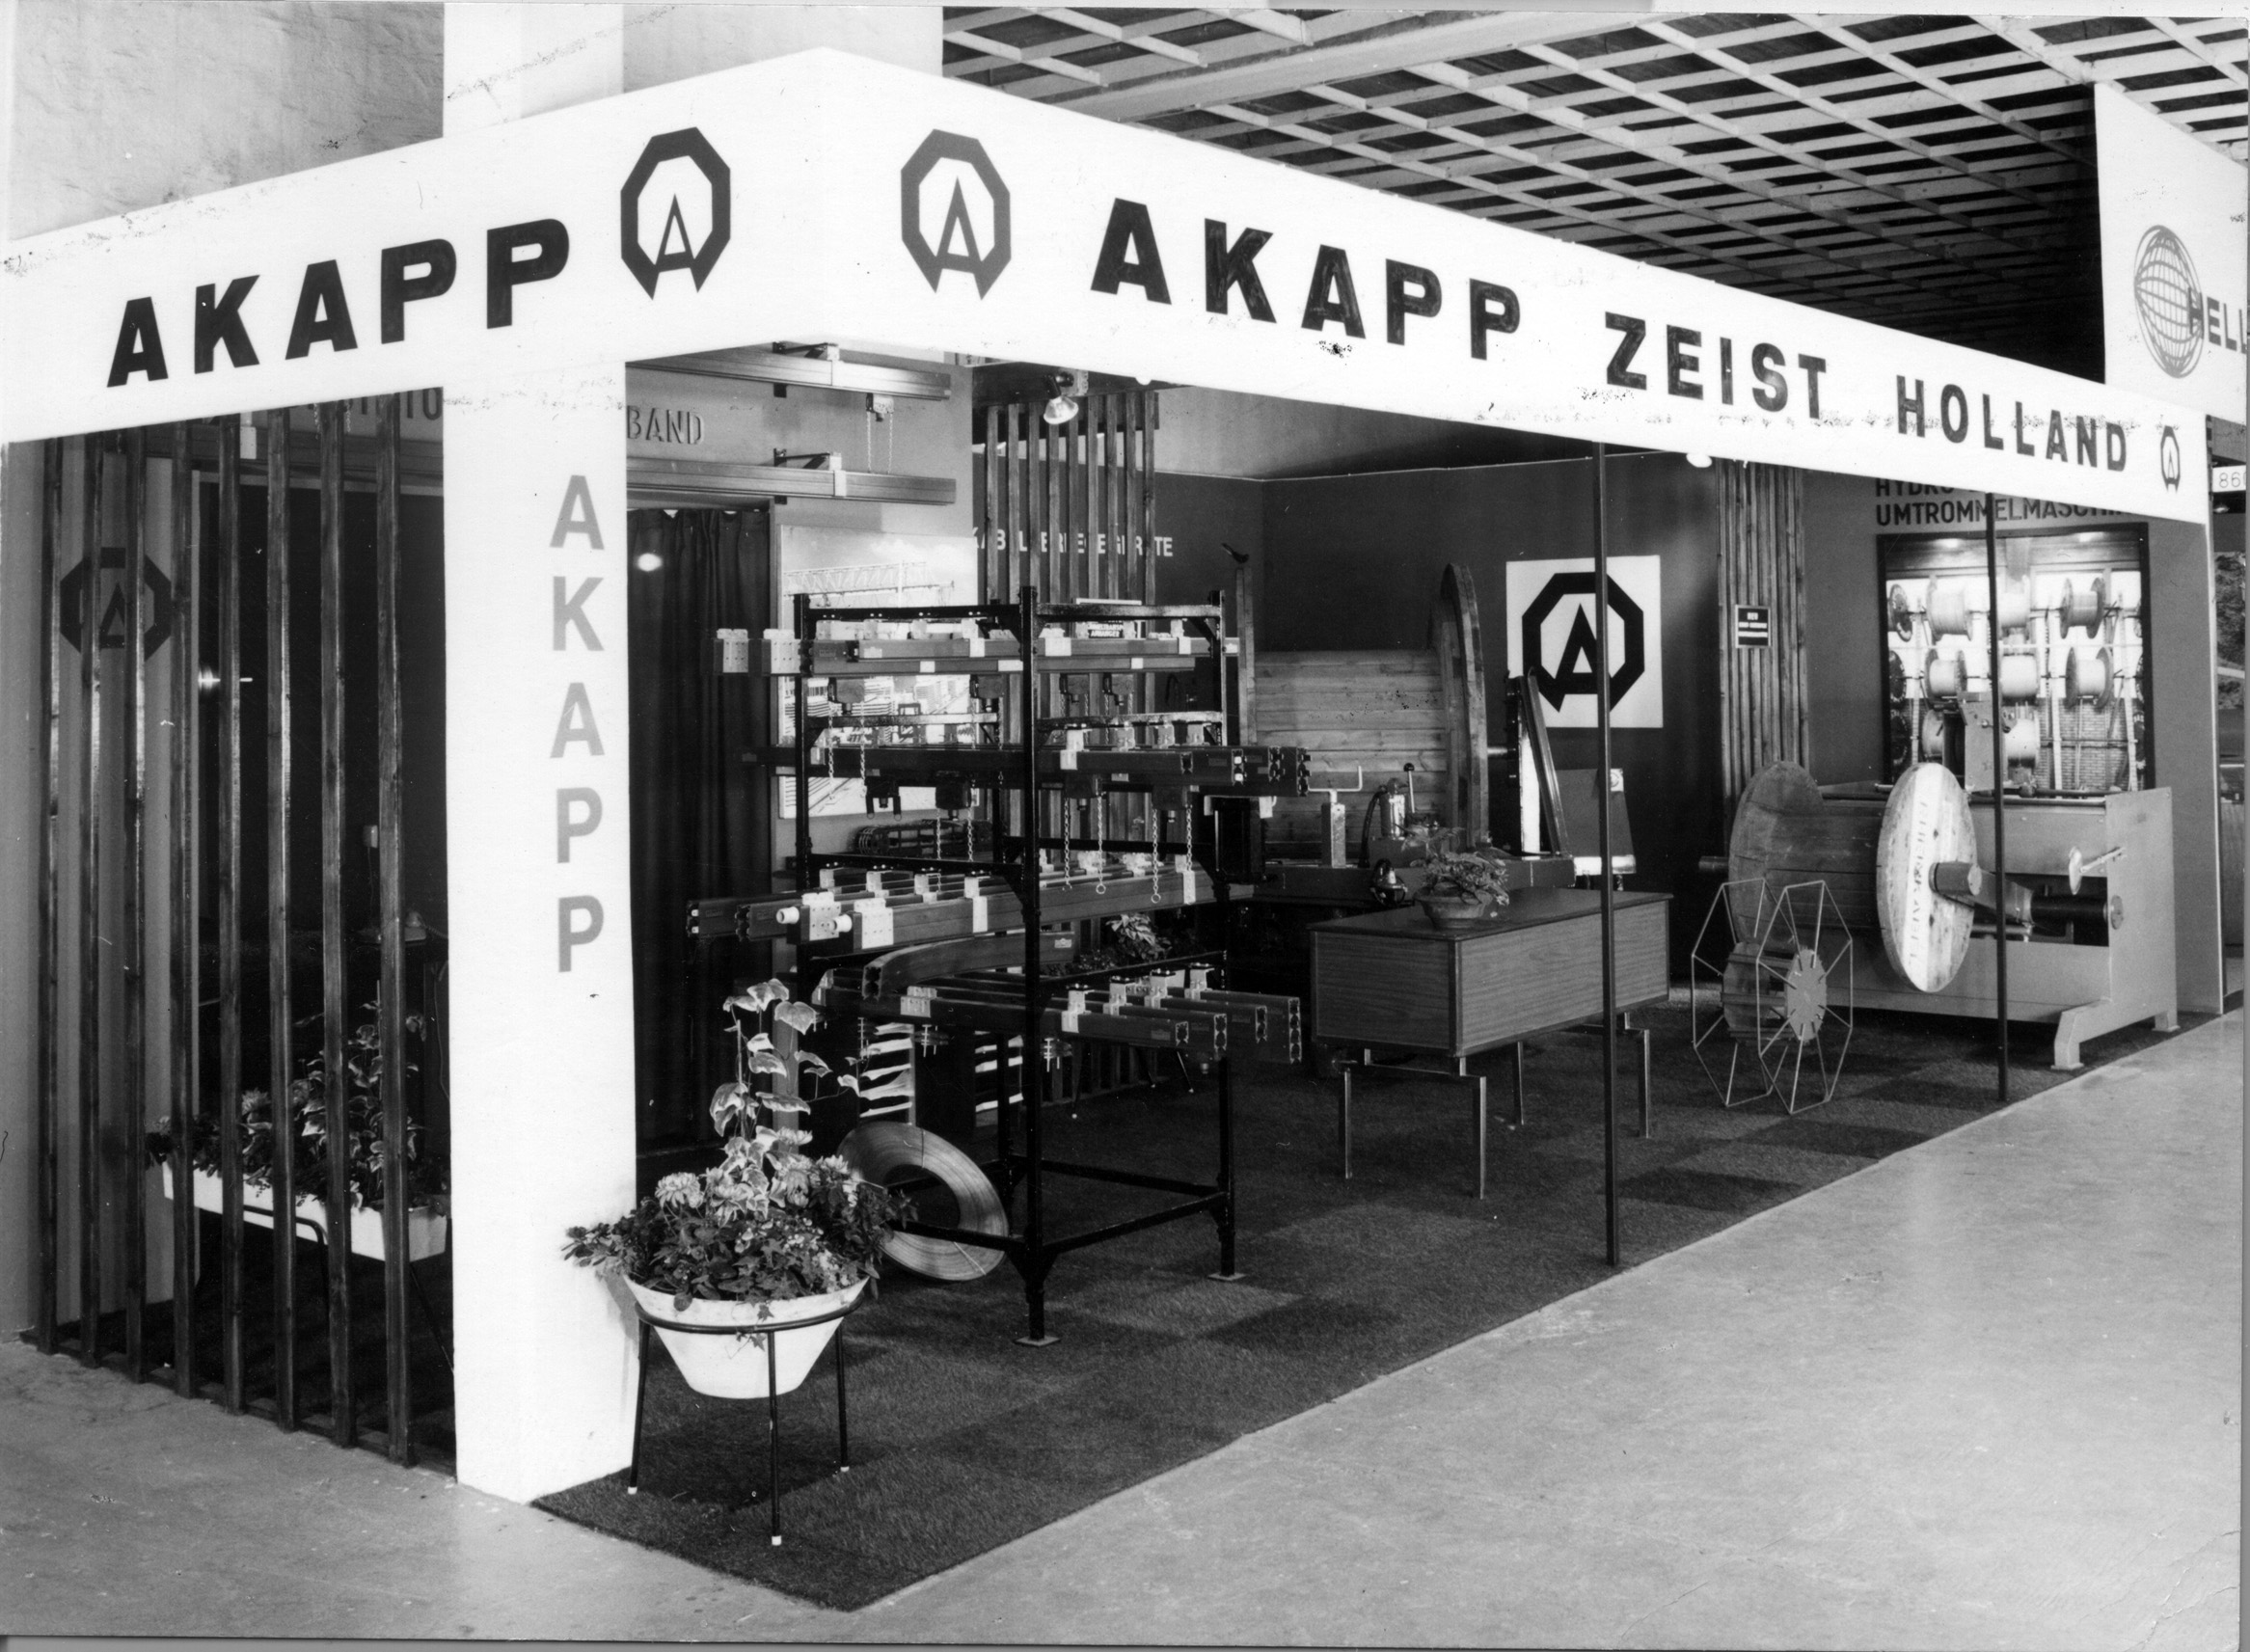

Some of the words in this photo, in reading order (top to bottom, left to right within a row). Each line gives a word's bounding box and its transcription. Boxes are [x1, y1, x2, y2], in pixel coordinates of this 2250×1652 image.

[107, 218, 570, 388] AKAPP
[1090, 198, 1521, 362] AKAPP
[1605, 311, 1828, 421] ZEIST
[1896, 374, 2128, 473] HOLLAND
[2219, 472, 2247, 488] 86
[549, 474, 606, 973] AKAPP
